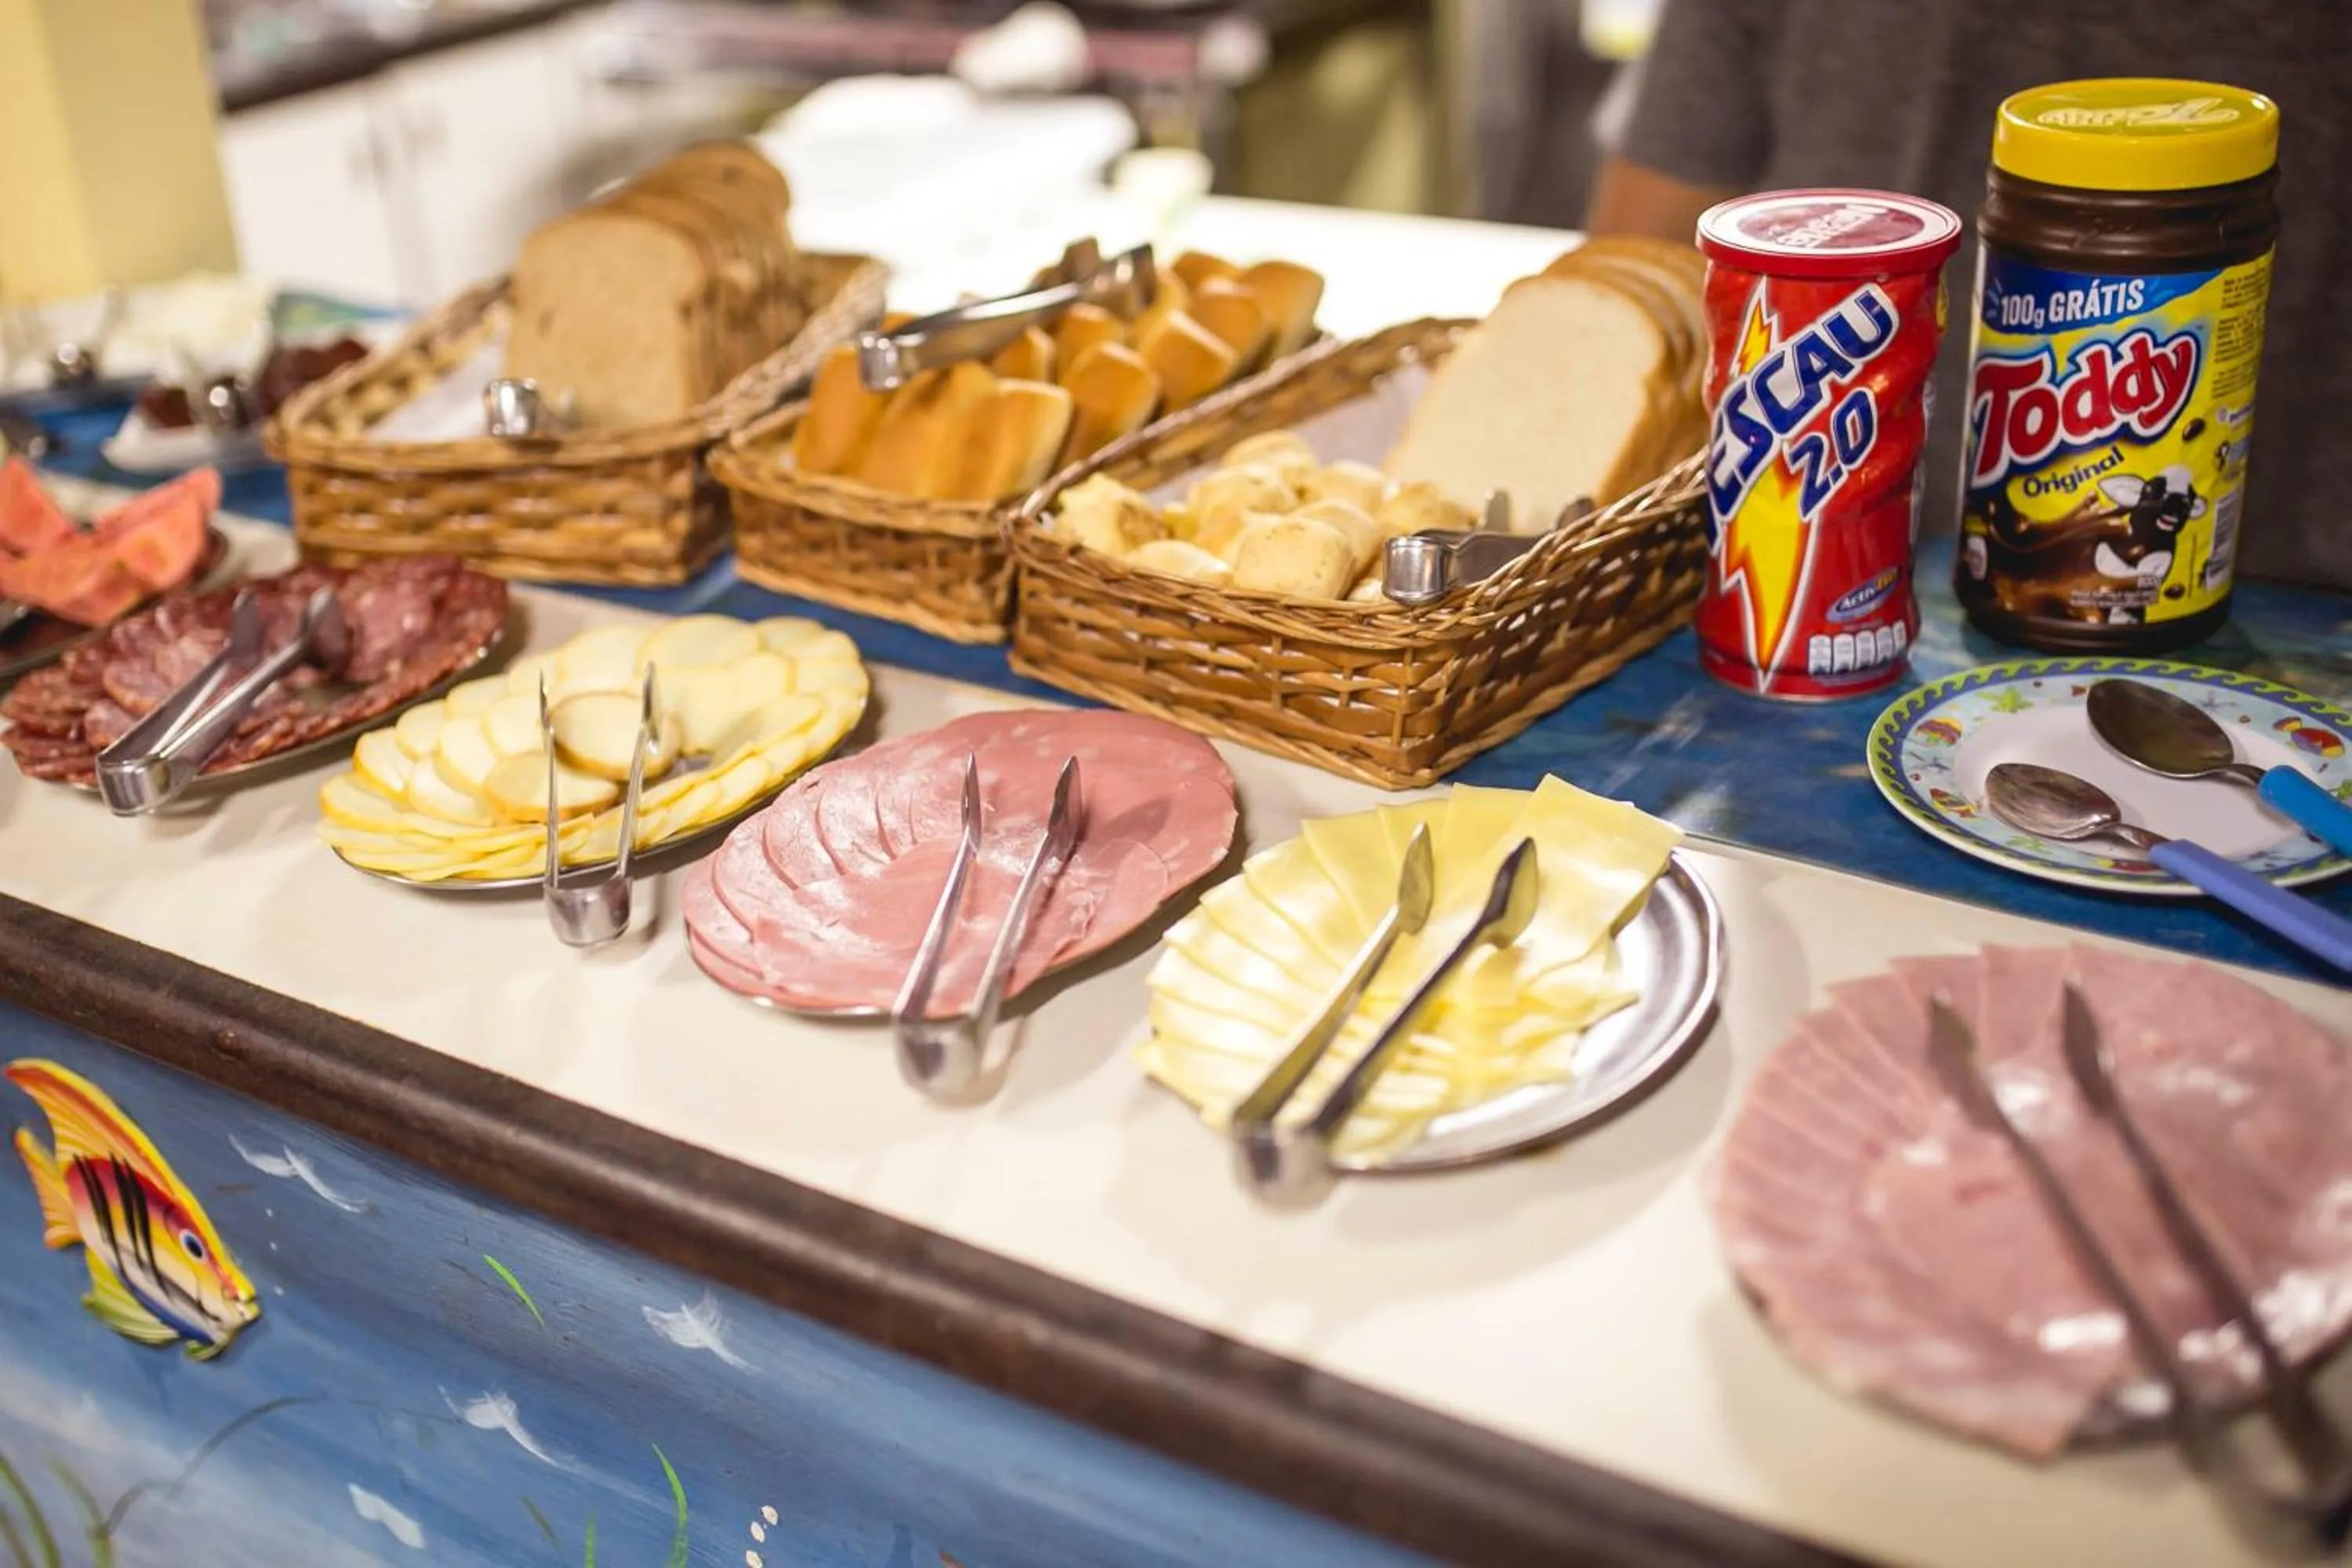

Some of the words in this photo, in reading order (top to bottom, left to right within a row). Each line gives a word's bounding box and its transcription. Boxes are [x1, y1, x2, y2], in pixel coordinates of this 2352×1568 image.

[2001, 294, 2045, 329] 100g
[2049, 278, 2146, 324] GRÁTIS
[1706, 288, 1895, 550] ESCAU
[1788, 388, 1876, 517] 2.0
[1973, 333, 2194, 483] Toddy
[2023, 445, 2125, 498] Original
